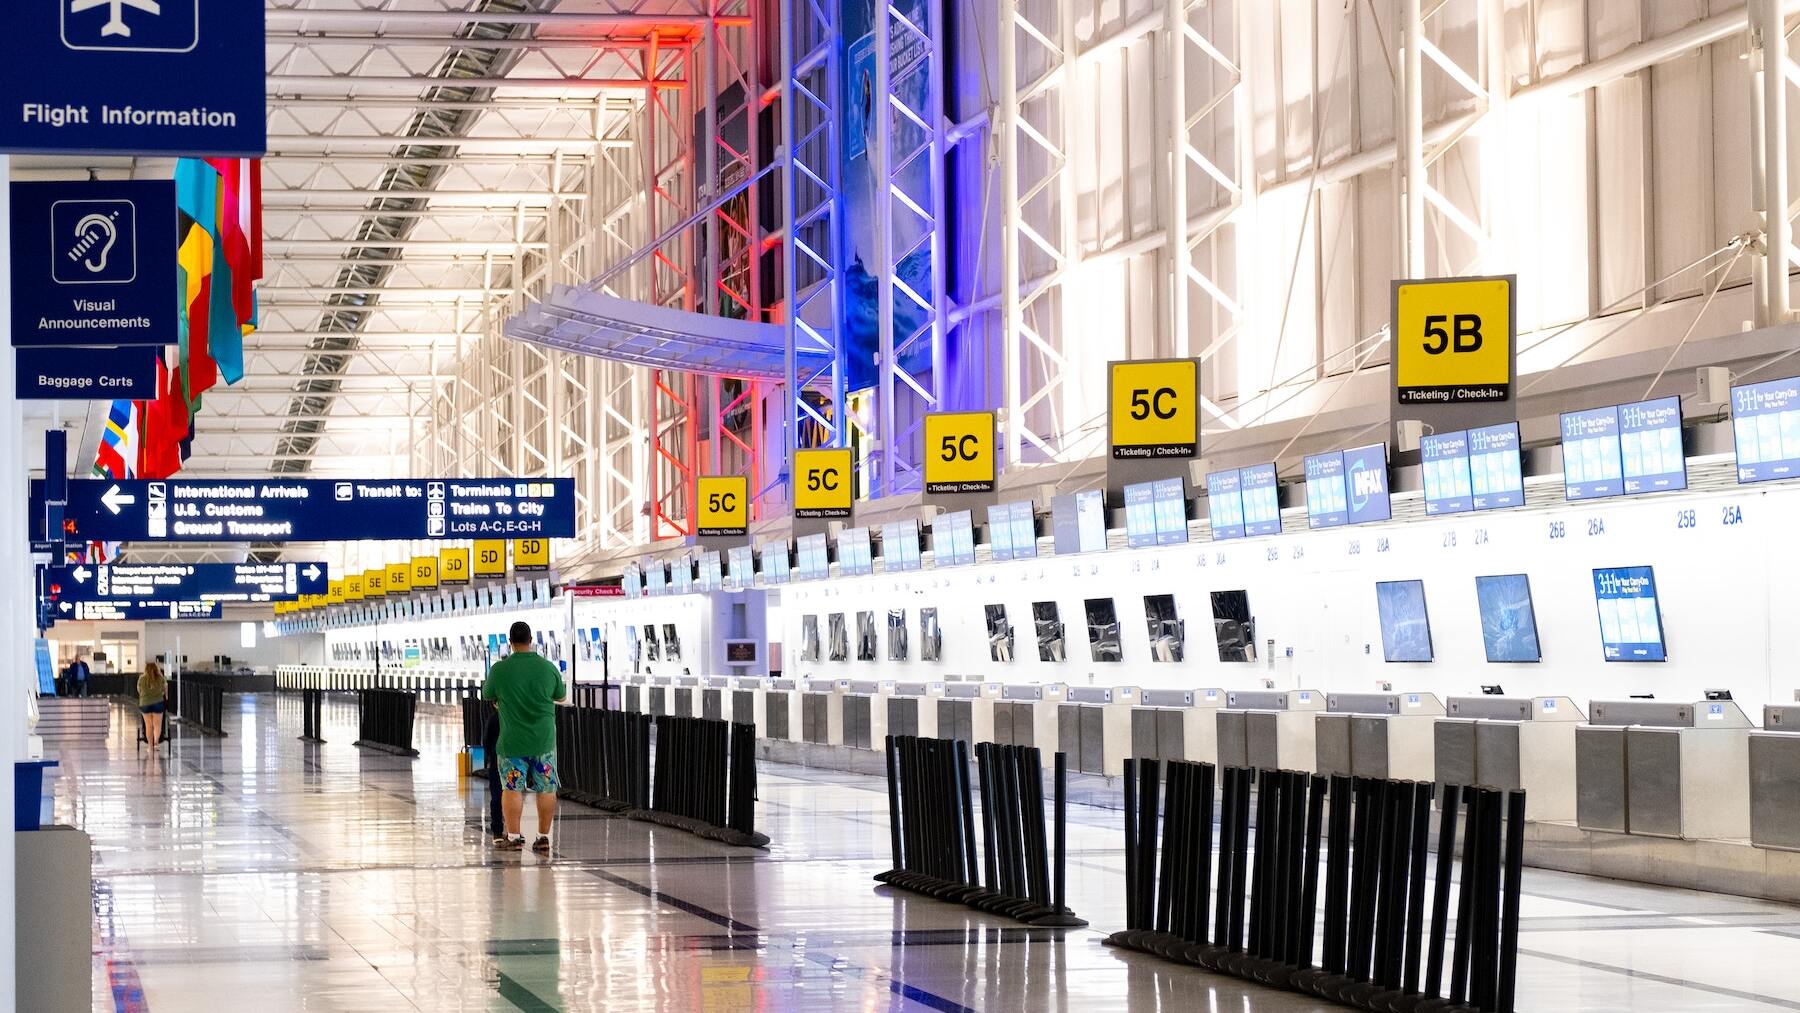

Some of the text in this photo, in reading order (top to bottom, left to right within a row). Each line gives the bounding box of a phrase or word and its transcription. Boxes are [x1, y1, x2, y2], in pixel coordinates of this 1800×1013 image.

[22, 104, 236, 127] Flight Information
[73, 299, 116, 312] Visual
[38, 317, 151, 329] Announcements
[1422, 313, 1483, 355] 5B
[38, 375, 134, 388] Baggage Carts
[1407, 390, 1450, 400] Ticketing
[1457, 388, 1498, 398] Check-In
[1736, 388, 1759, 412] 3-1-1
[1130, 387, 1177, 421] 5C
[1622, 406, 1641, 429] 3-1-1
[1565, 416, 1582, 436] 3-1-1
[941, 434, 979, 462] 5C
[1120, 448, 1152, 457] Ticketing
[1156, 446, 1188, 455] Check-In
[808, 468, 838, 492] 5C
[1354, 468, 1384, 497] INFAX
[174, 485, 310, 498] International Arrivals
[356, 485, 422, 498] Transit to:
[450, 484, 512, 498] Terminals
[932, 484, 958, 492] Ticketing
[174, 503, 264, 516] U.S. Customs
[450, 502, 544, 517] Trains To City
[708, 492, 736, 513] 5C
[1678, 509, 1696, 528] 25B
[1722, 505, 1743, 525] 25A
[174, 520, 292, 537] Ground Transport
[450, 520, 542, 534] Lots A-C,E-G-H
[1549, 521, 1566, 539] 26B
[1588, 518, 1605, 536] 26A
[1443, 531, 1457, 548] 27B
[1474, 528, 1489, 546] 27A
[522, 540, 540, 555] 5D
[446, 558, 462, 571] 5D
[481, 550, 498, 564] 5D
[392, 572, 405, 584] 5E
[416, 566, 432, 578] 5D
[350, 582, 360, 592] 5E
[369, 578, 382, 588] 5E
[1598, 572, 1618, 594] 3-1-1
[332, 587, 342, 596] 5E
